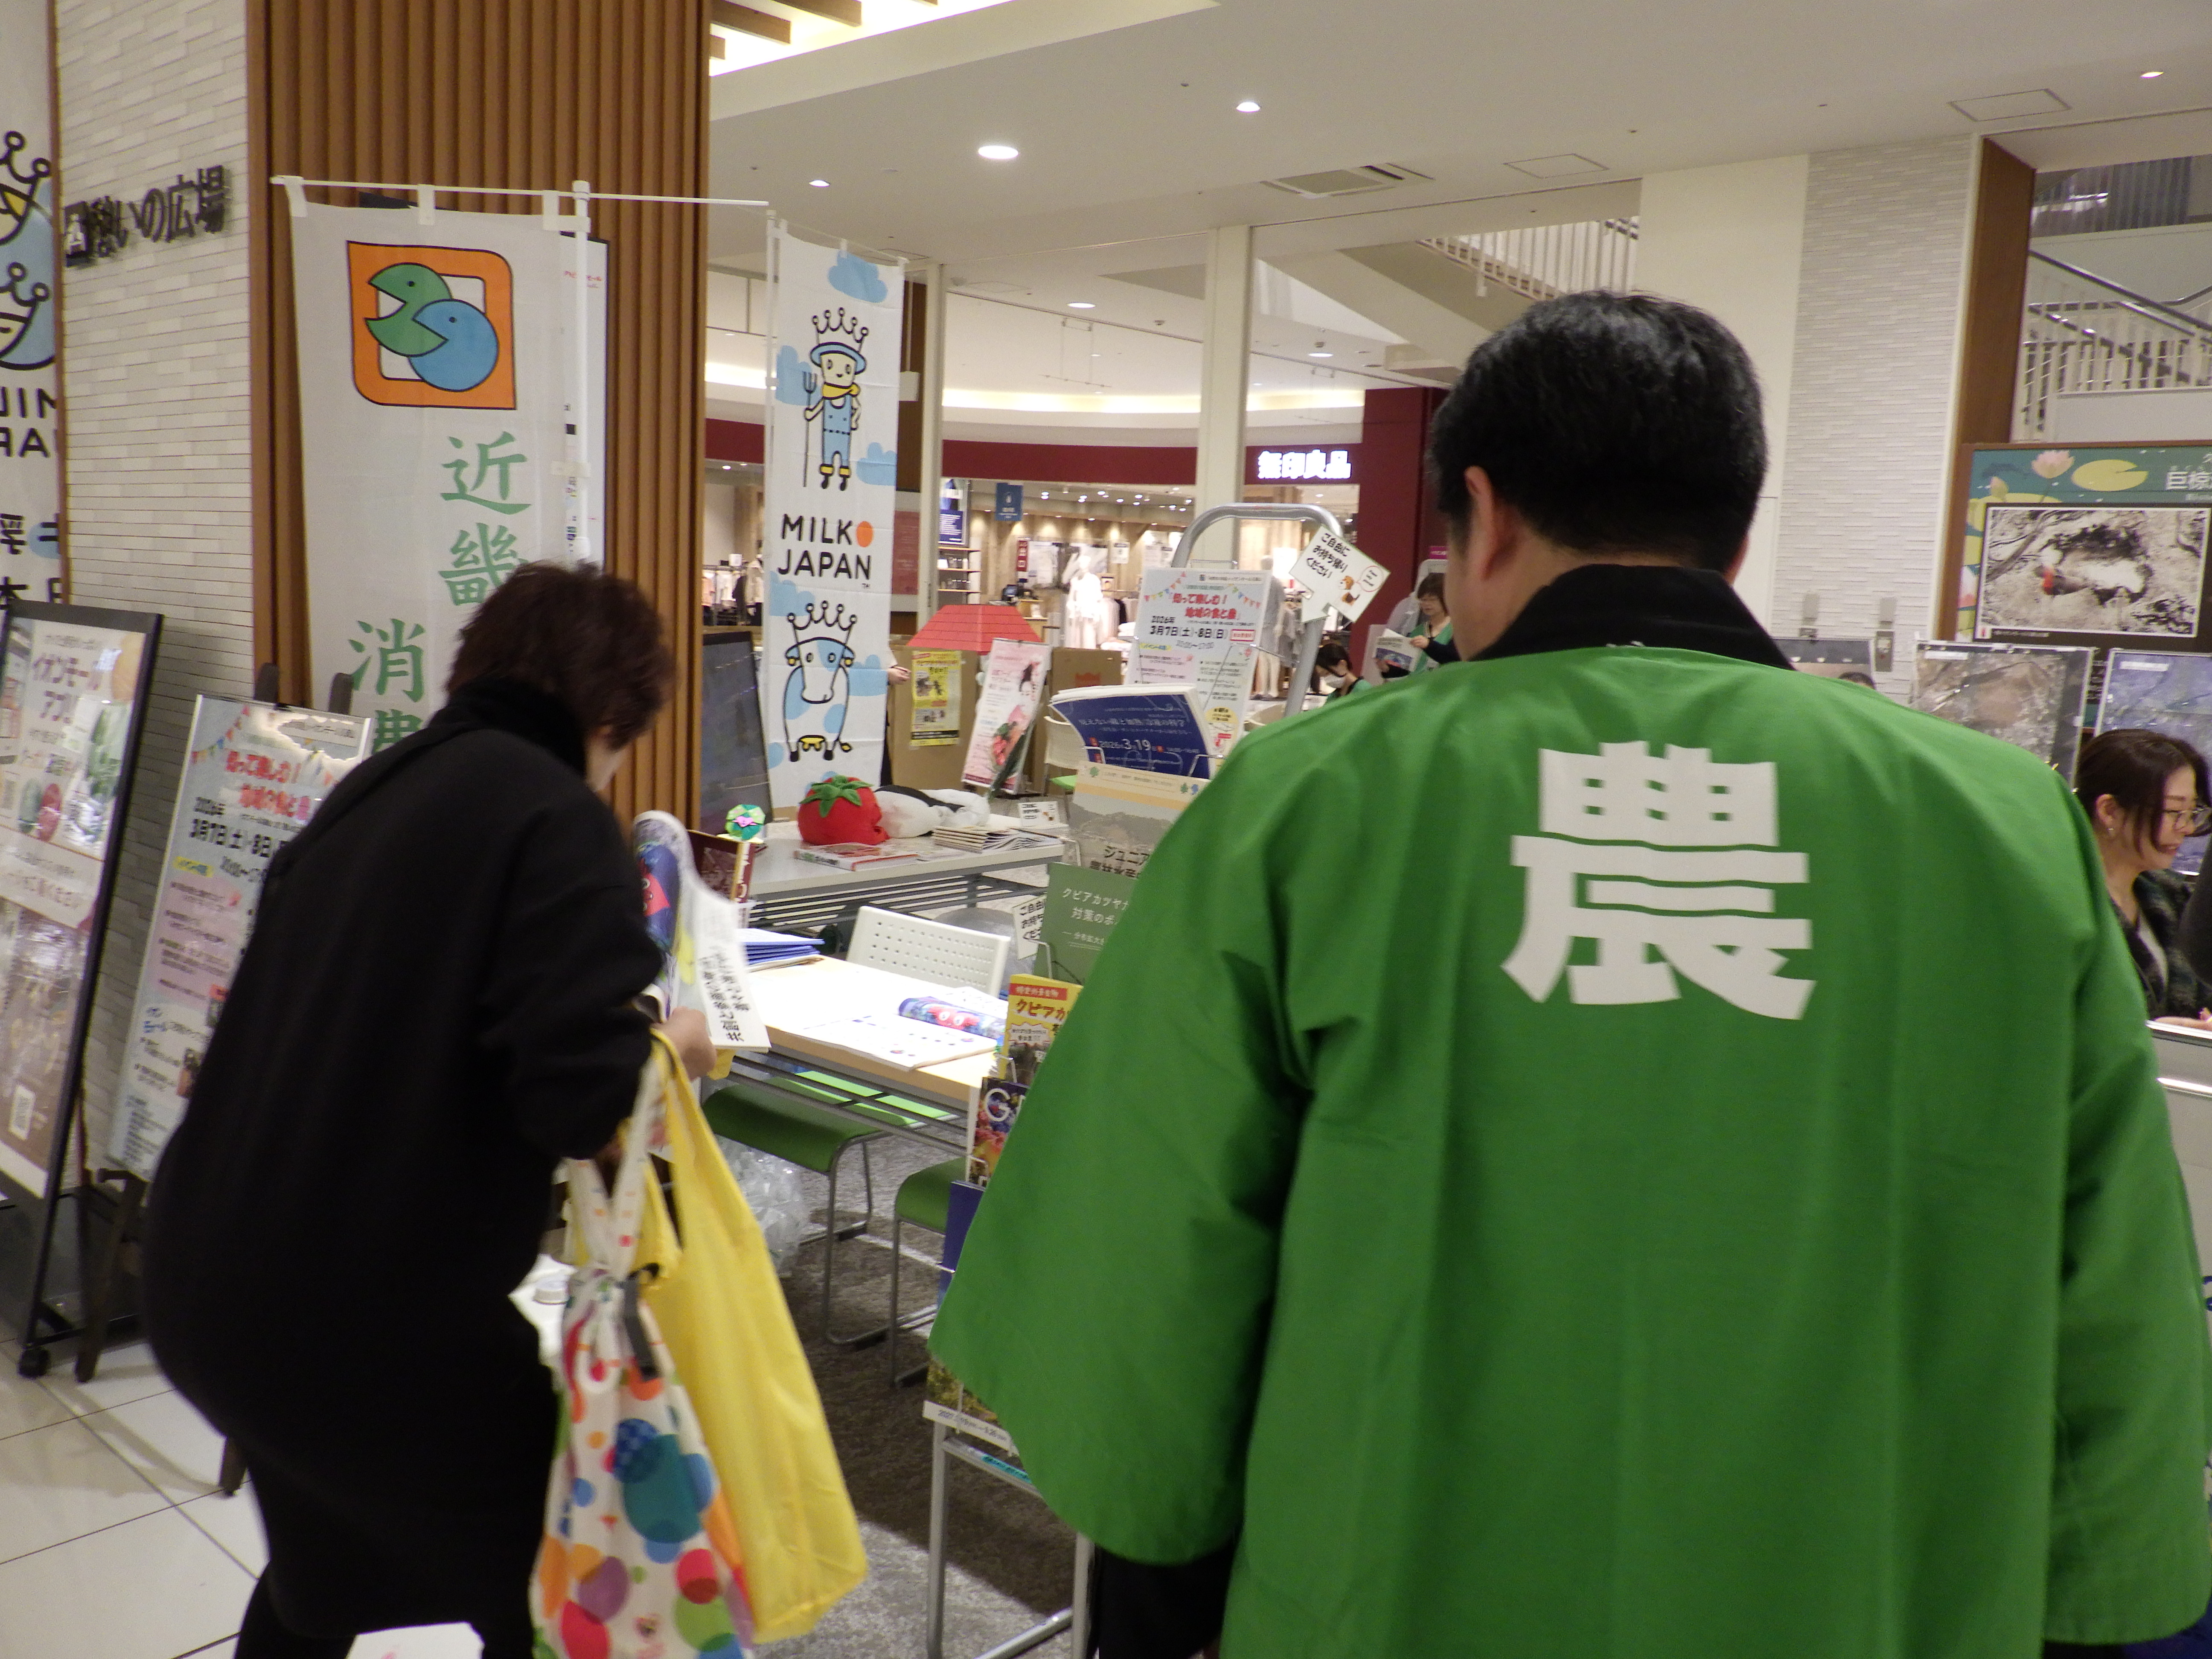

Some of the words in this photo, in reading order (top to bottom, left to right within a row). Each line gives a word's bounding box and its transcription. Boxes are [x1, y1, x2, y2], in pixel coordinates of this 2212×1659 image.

[1257, 449, 1352, 479] 無印良品
[781, 513, 853, 545] MILK
[777, 549, 872, 580] JAPAN
[1501, 740, 1817, 1020] 農
